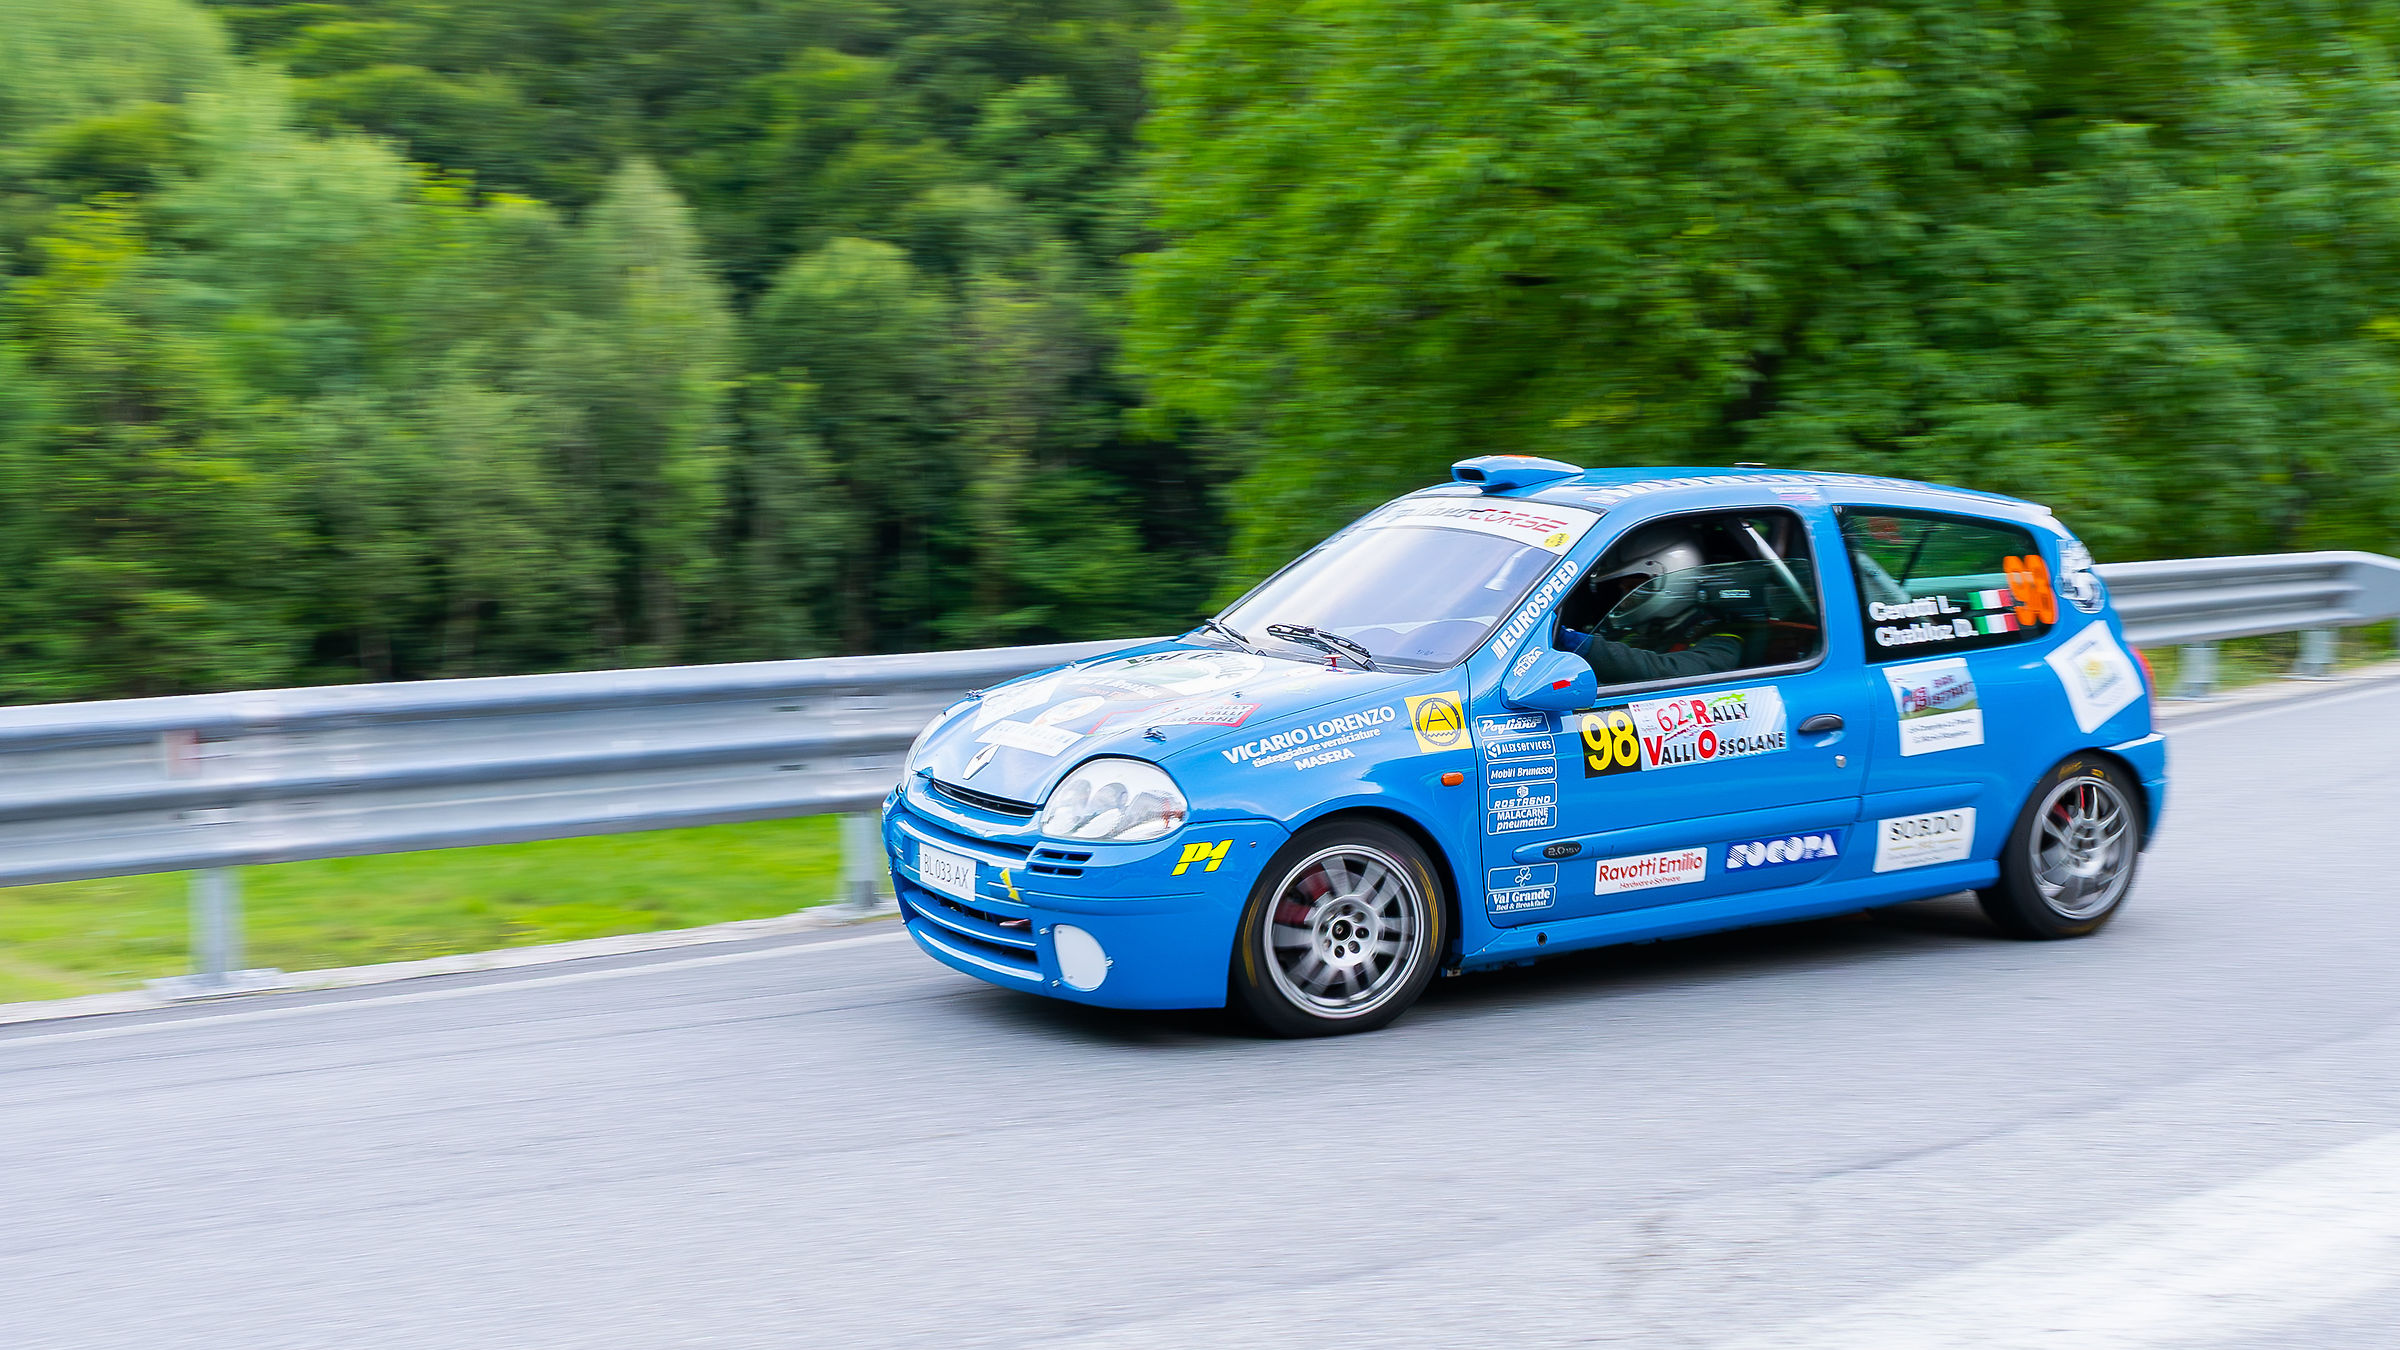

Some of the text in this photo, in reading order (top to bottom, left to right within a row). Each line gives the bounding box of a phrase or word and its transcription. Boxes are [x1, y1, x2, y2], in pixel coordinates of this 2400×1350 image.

[1500, 560, 1579, 649] EUROSPEED
[1690, 699, 1749, 724] RALLY
[1221, 705, 1396, 764] VICARIO LORENZO
[1481, 718, 1537, 735] Pogliano
[1252, 727, 1381, 768] tinteggiature verniciature
[1580, 711, 1640, 771] 98
[1293, 747, 1356, 771] MASERA
[1494, 795, 1551, 809] ROSTAGNO
[1497, 807, 1549, 821] MALACARNE
[1496, 817, 1548, 833] pneumatici
[1170, 839, 1236, 877] P1
[1726, 833, 1839, 869] SOCOPA
[924, 853, 970, 889] BL 033 AX
[1599, 851, 1703, 882] Ravotti Emilio
[1493, 888, 1551, 905] Val Grande
[1516, 899, 1547, 908] Breakfast
